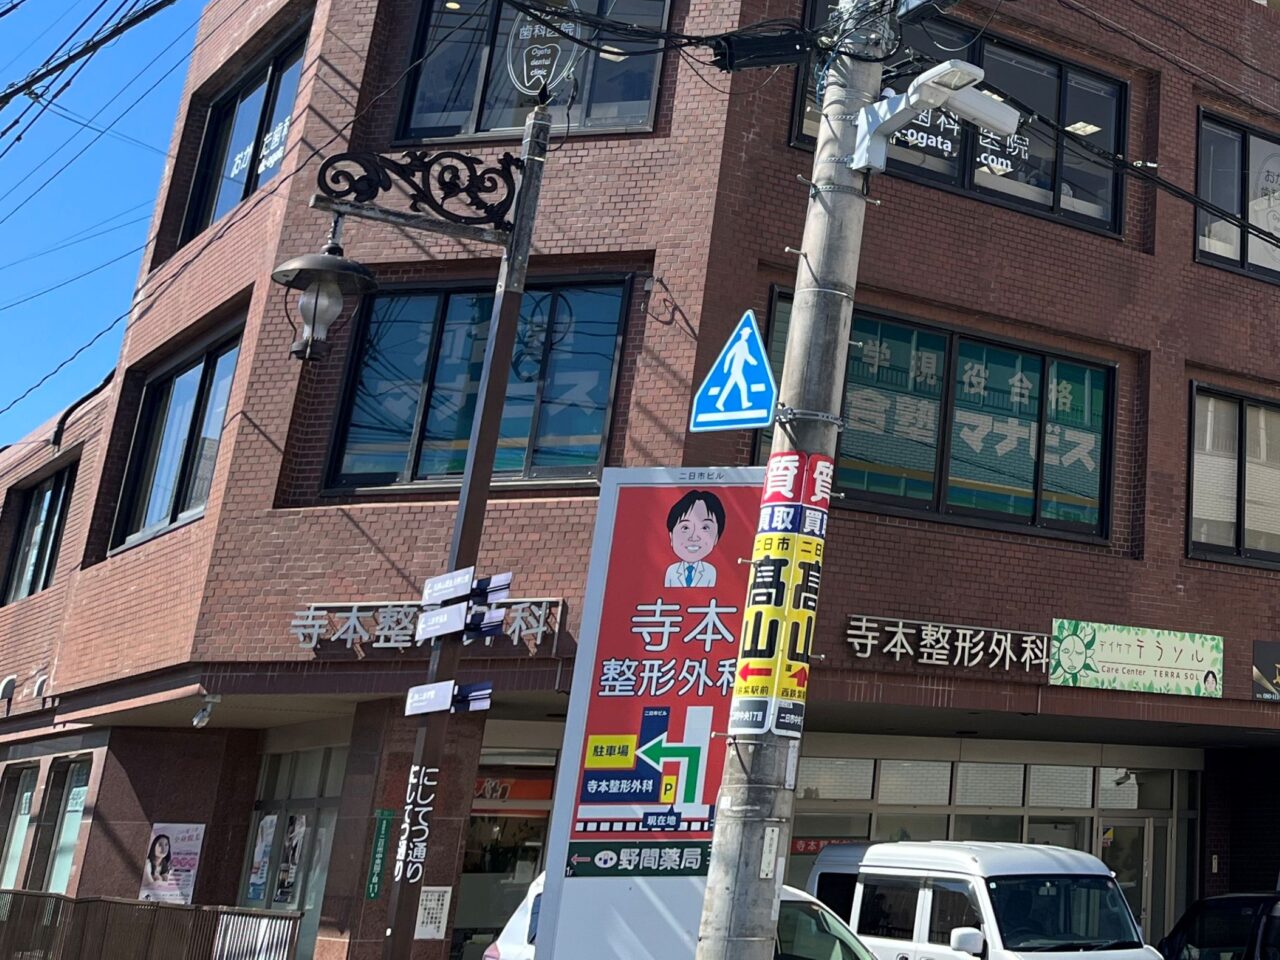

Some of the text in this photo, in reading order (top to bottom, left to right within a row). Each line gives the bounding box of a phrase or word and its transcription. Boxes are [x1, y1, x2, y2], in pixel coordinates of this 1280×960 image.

[678, 472, 725, 481] 二日市ビル
[763, 454, 800, 501] 質
[757, 506, 795, 531] 買取
[803, 510, 828, 535] 買
[755, 537, 790, 551] 二日市
[290, 602, 547, 649] 寺本整科
[630, 597, 738, 653] 寺本
[846, 617, 1049, 674] 寺本整形外科
[1136, 638, 1204, 664] テラソル
[1101, 665, 1199, 681] Care Center TERRA SOL
[592, 744, 630, 757] 駐車場
[587, 779, 654, 794] 寺本整形外科
[406, 765, 440, 883] にしてつ通り
[647, 815, 677, 826] 現在地
[617, 847, 702, 871] 野間薬局
